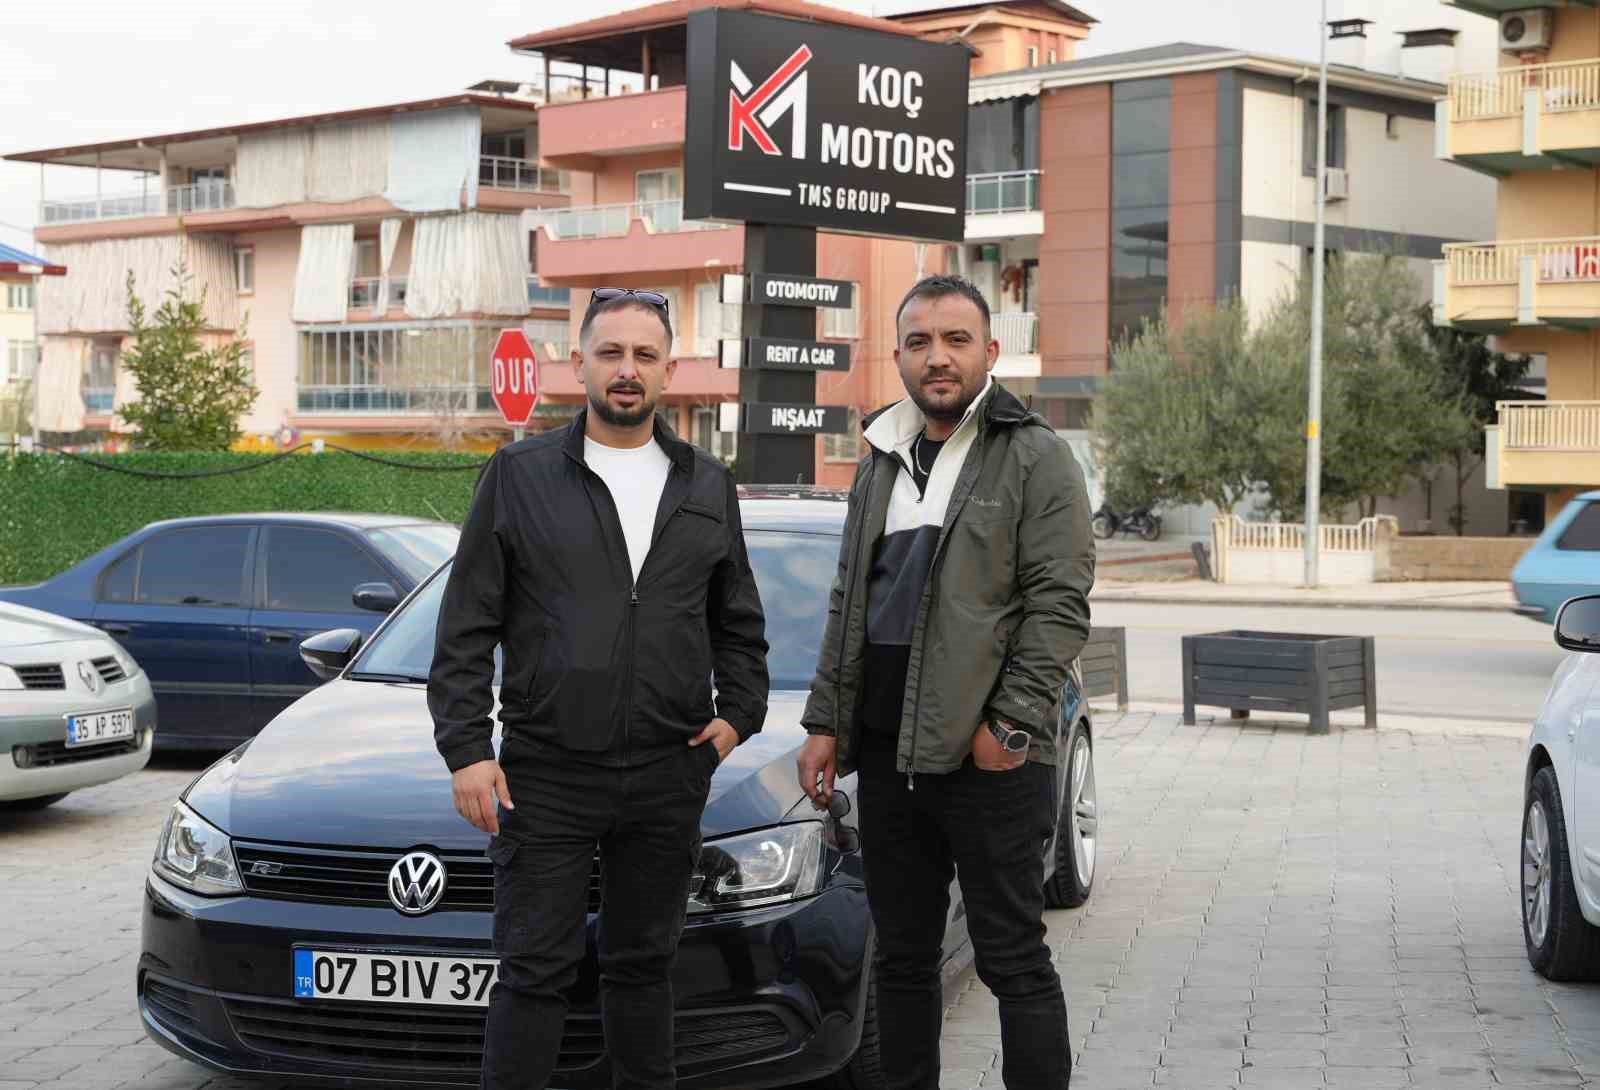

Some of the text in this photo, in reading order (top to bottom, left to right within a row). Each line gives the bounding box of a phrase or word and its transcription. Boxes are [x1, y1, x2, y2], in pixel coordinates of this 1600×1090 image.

[858, 63, 924, 118] KOÇ
[821, 123, 955, 178] MOTORS
[798, 183, 891, 214] TMS GROUP
[766, 345, 835, 365] RENT A CAR
[495, 358, 535, 394] DUR
[76, 719, 88, 738] 35
[96, 716, 106, 736] AP
[297, 976, 312, 988] TR
[314, 956, 500, 1001] 07 BIV 37
